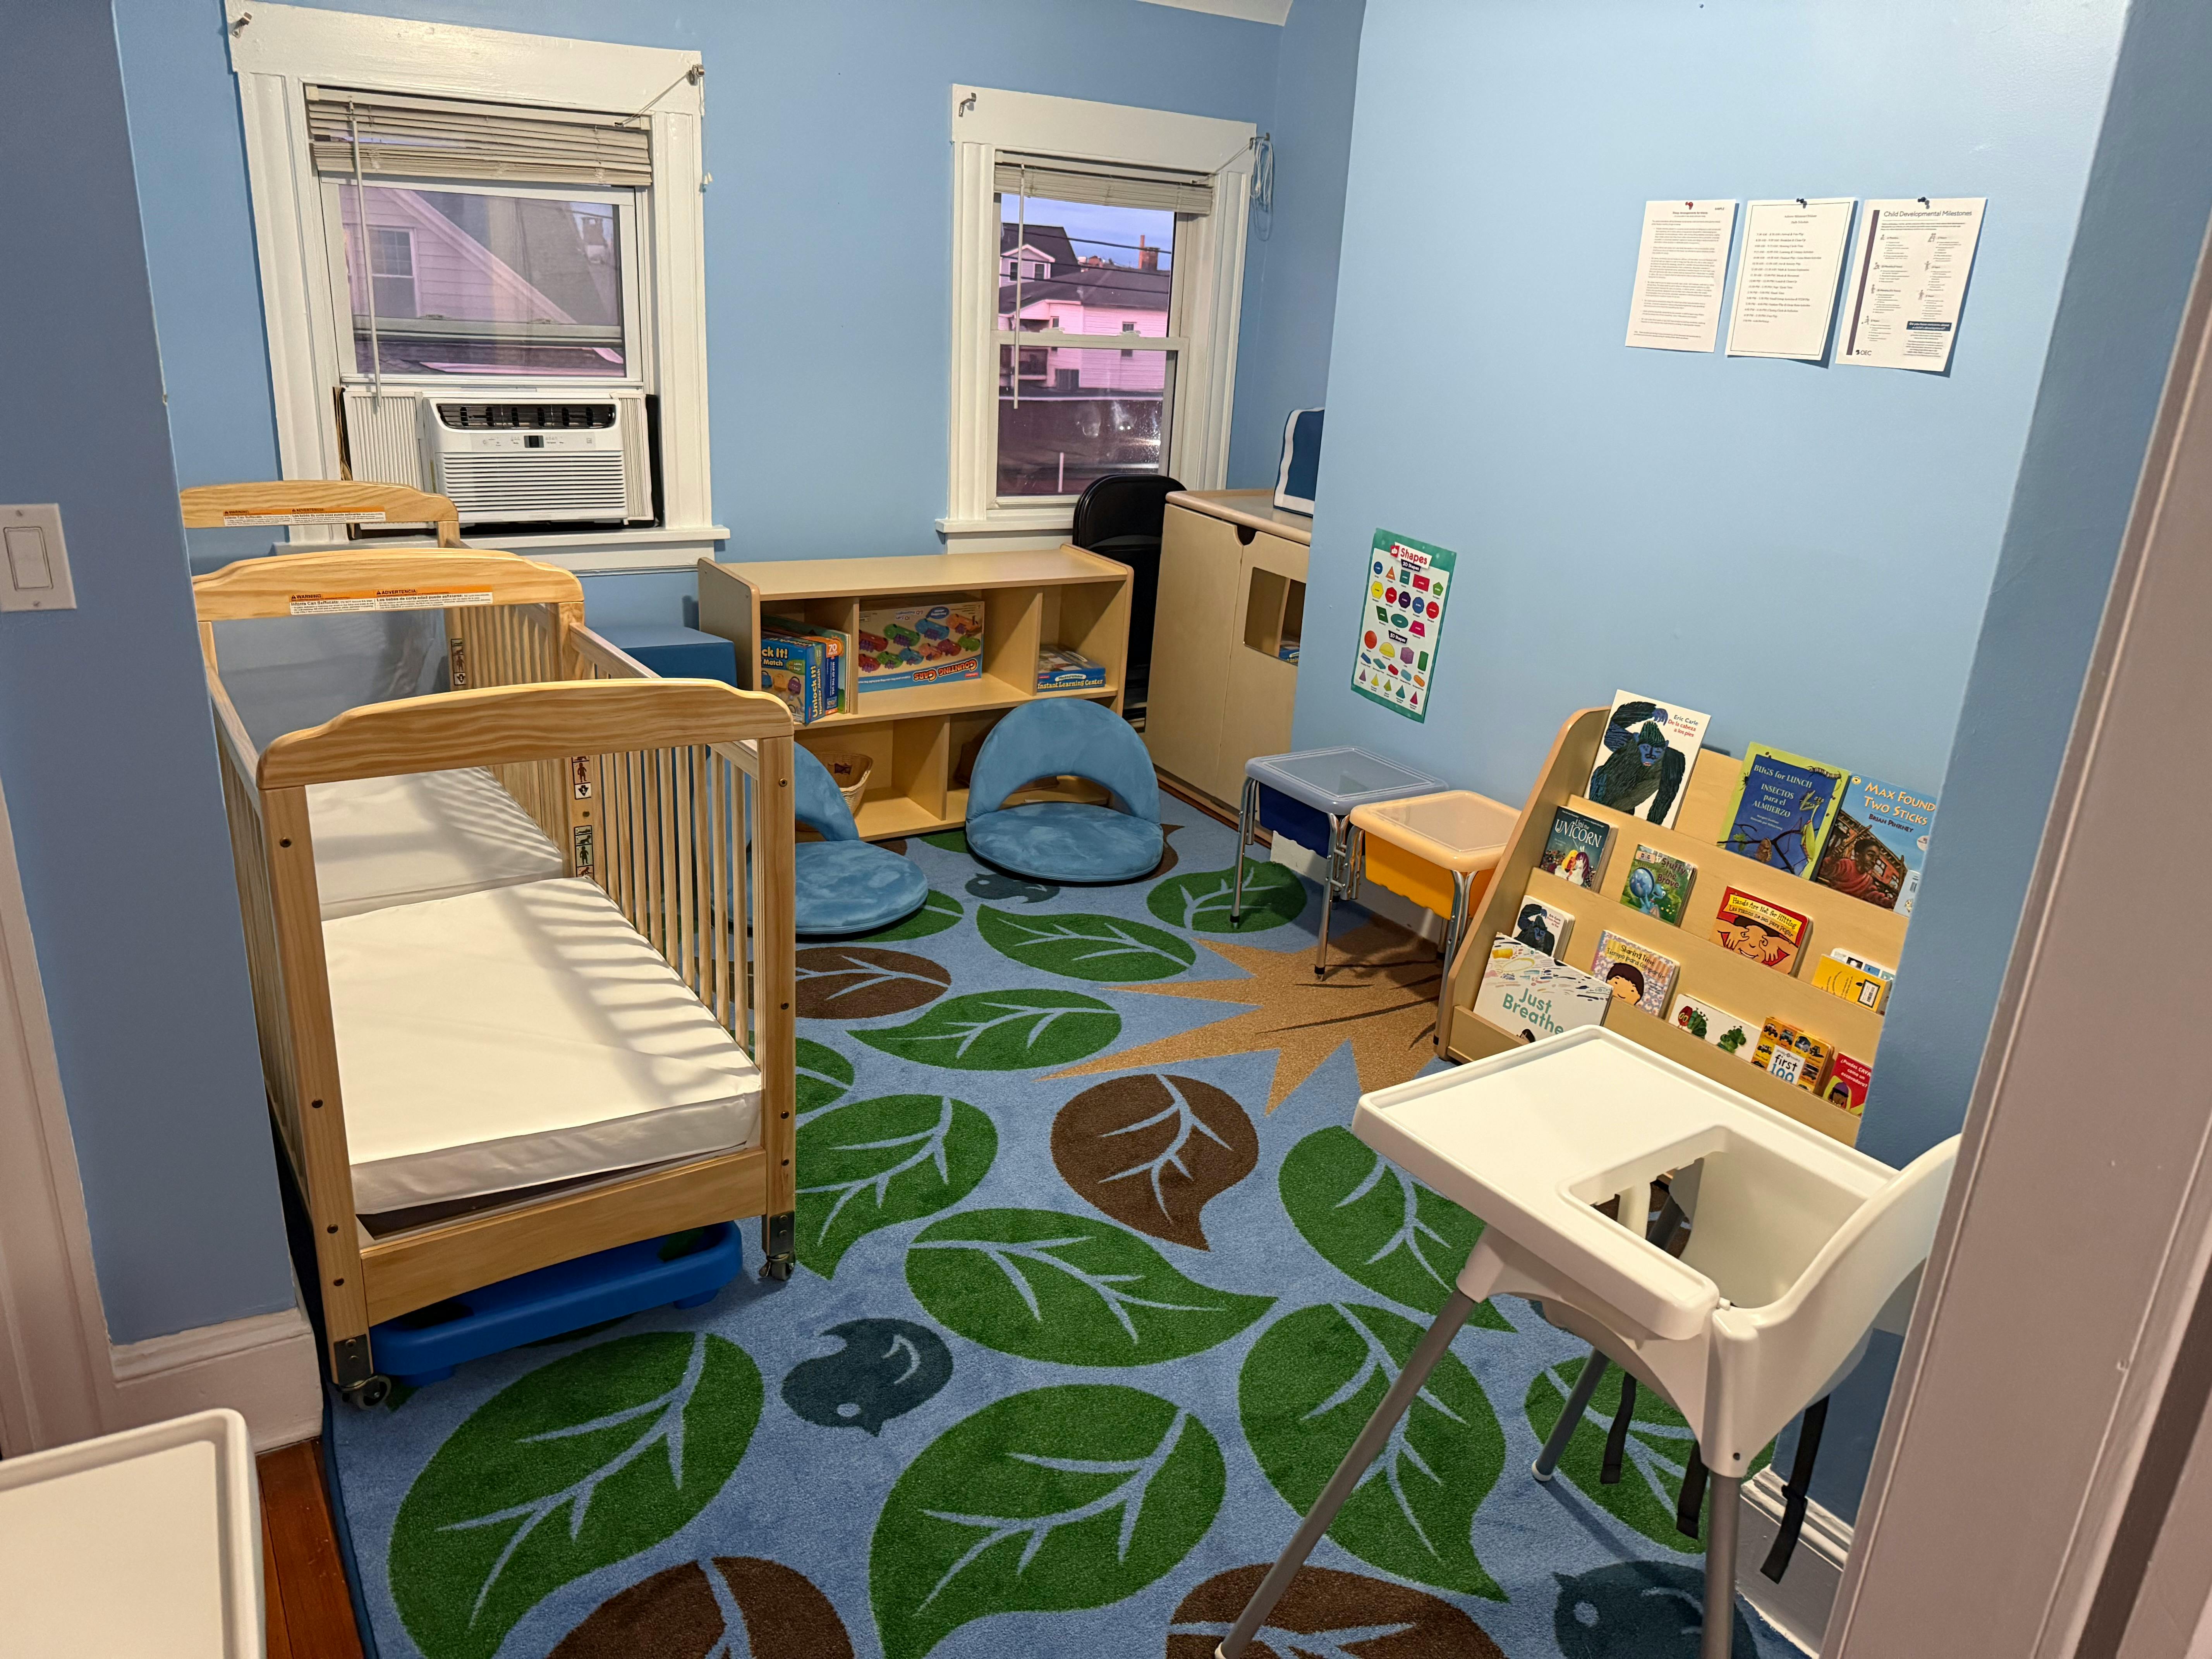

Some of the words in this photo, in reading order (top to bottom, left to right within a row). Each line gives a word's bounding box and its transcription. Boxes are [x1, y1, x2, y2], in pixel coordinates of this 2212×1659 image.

[1400, 548, 1427, 565] Shapes
[776, 648, 788, 659] It!
[828, 644, 837, 652] 70
[914, 669, 937, 682] CARS
[938, 658, 977, 677] COUNTING
[1753, 764, 1774, 776] BUGS
[1774, 771, 1786, 780] for
[1786, 775, 1813, 788] LUNCH
[1761, 783, 1795, 800] INSECTOS
[1763, 795, 1778, 804] para
[1865, 782, 1896, 800] MAX
[1898, 791, 1936, 812] FOUND
[1752, 800, 1791, 818] ALMUERZO
[1864, 796, 1890, 813] TWO
[1893, 806, 1928, 826] STICKS
[1575, 819, 1585, 828] Uni
[1869, 813, 1887, 824] BRIAN
[1887, 820, 1914, 833] PINKNEY
[1661, 858, 1686, 876] Stuffy
[1666, 870, 1677, 879] the
[1657, 874, 1680, 888] Brave
[1733, 897, 1749, 906] Hands
[1760, 906, 1769, 914] Not
[1777, 913, 1797, 930] Hitting
[1738, 908, 1754, 916] manos
[1769, 920, 1780, 928] para
[1779, 926, 1794, 937] pegar
[1607, 948, 1625, 959] Tiempo
[1625, 956, 1639, 965] para
[1621, 945, 1642, 960] Sharing
[1643, 954, 1655, 966] Time
[1519, 988, 1552, 1014] Just
[1503, 993, 1564, 1035] Breathe
[1775, 1054, 1798, 1072] first
[1841, 1059, 1858, 1070] ¿Puedes
[1858, 1067, 1871, 1077] CAVA
[1770, 1063, 1794, 1083] 100
[1841, 1072, 1868, 1087] excavadora?
